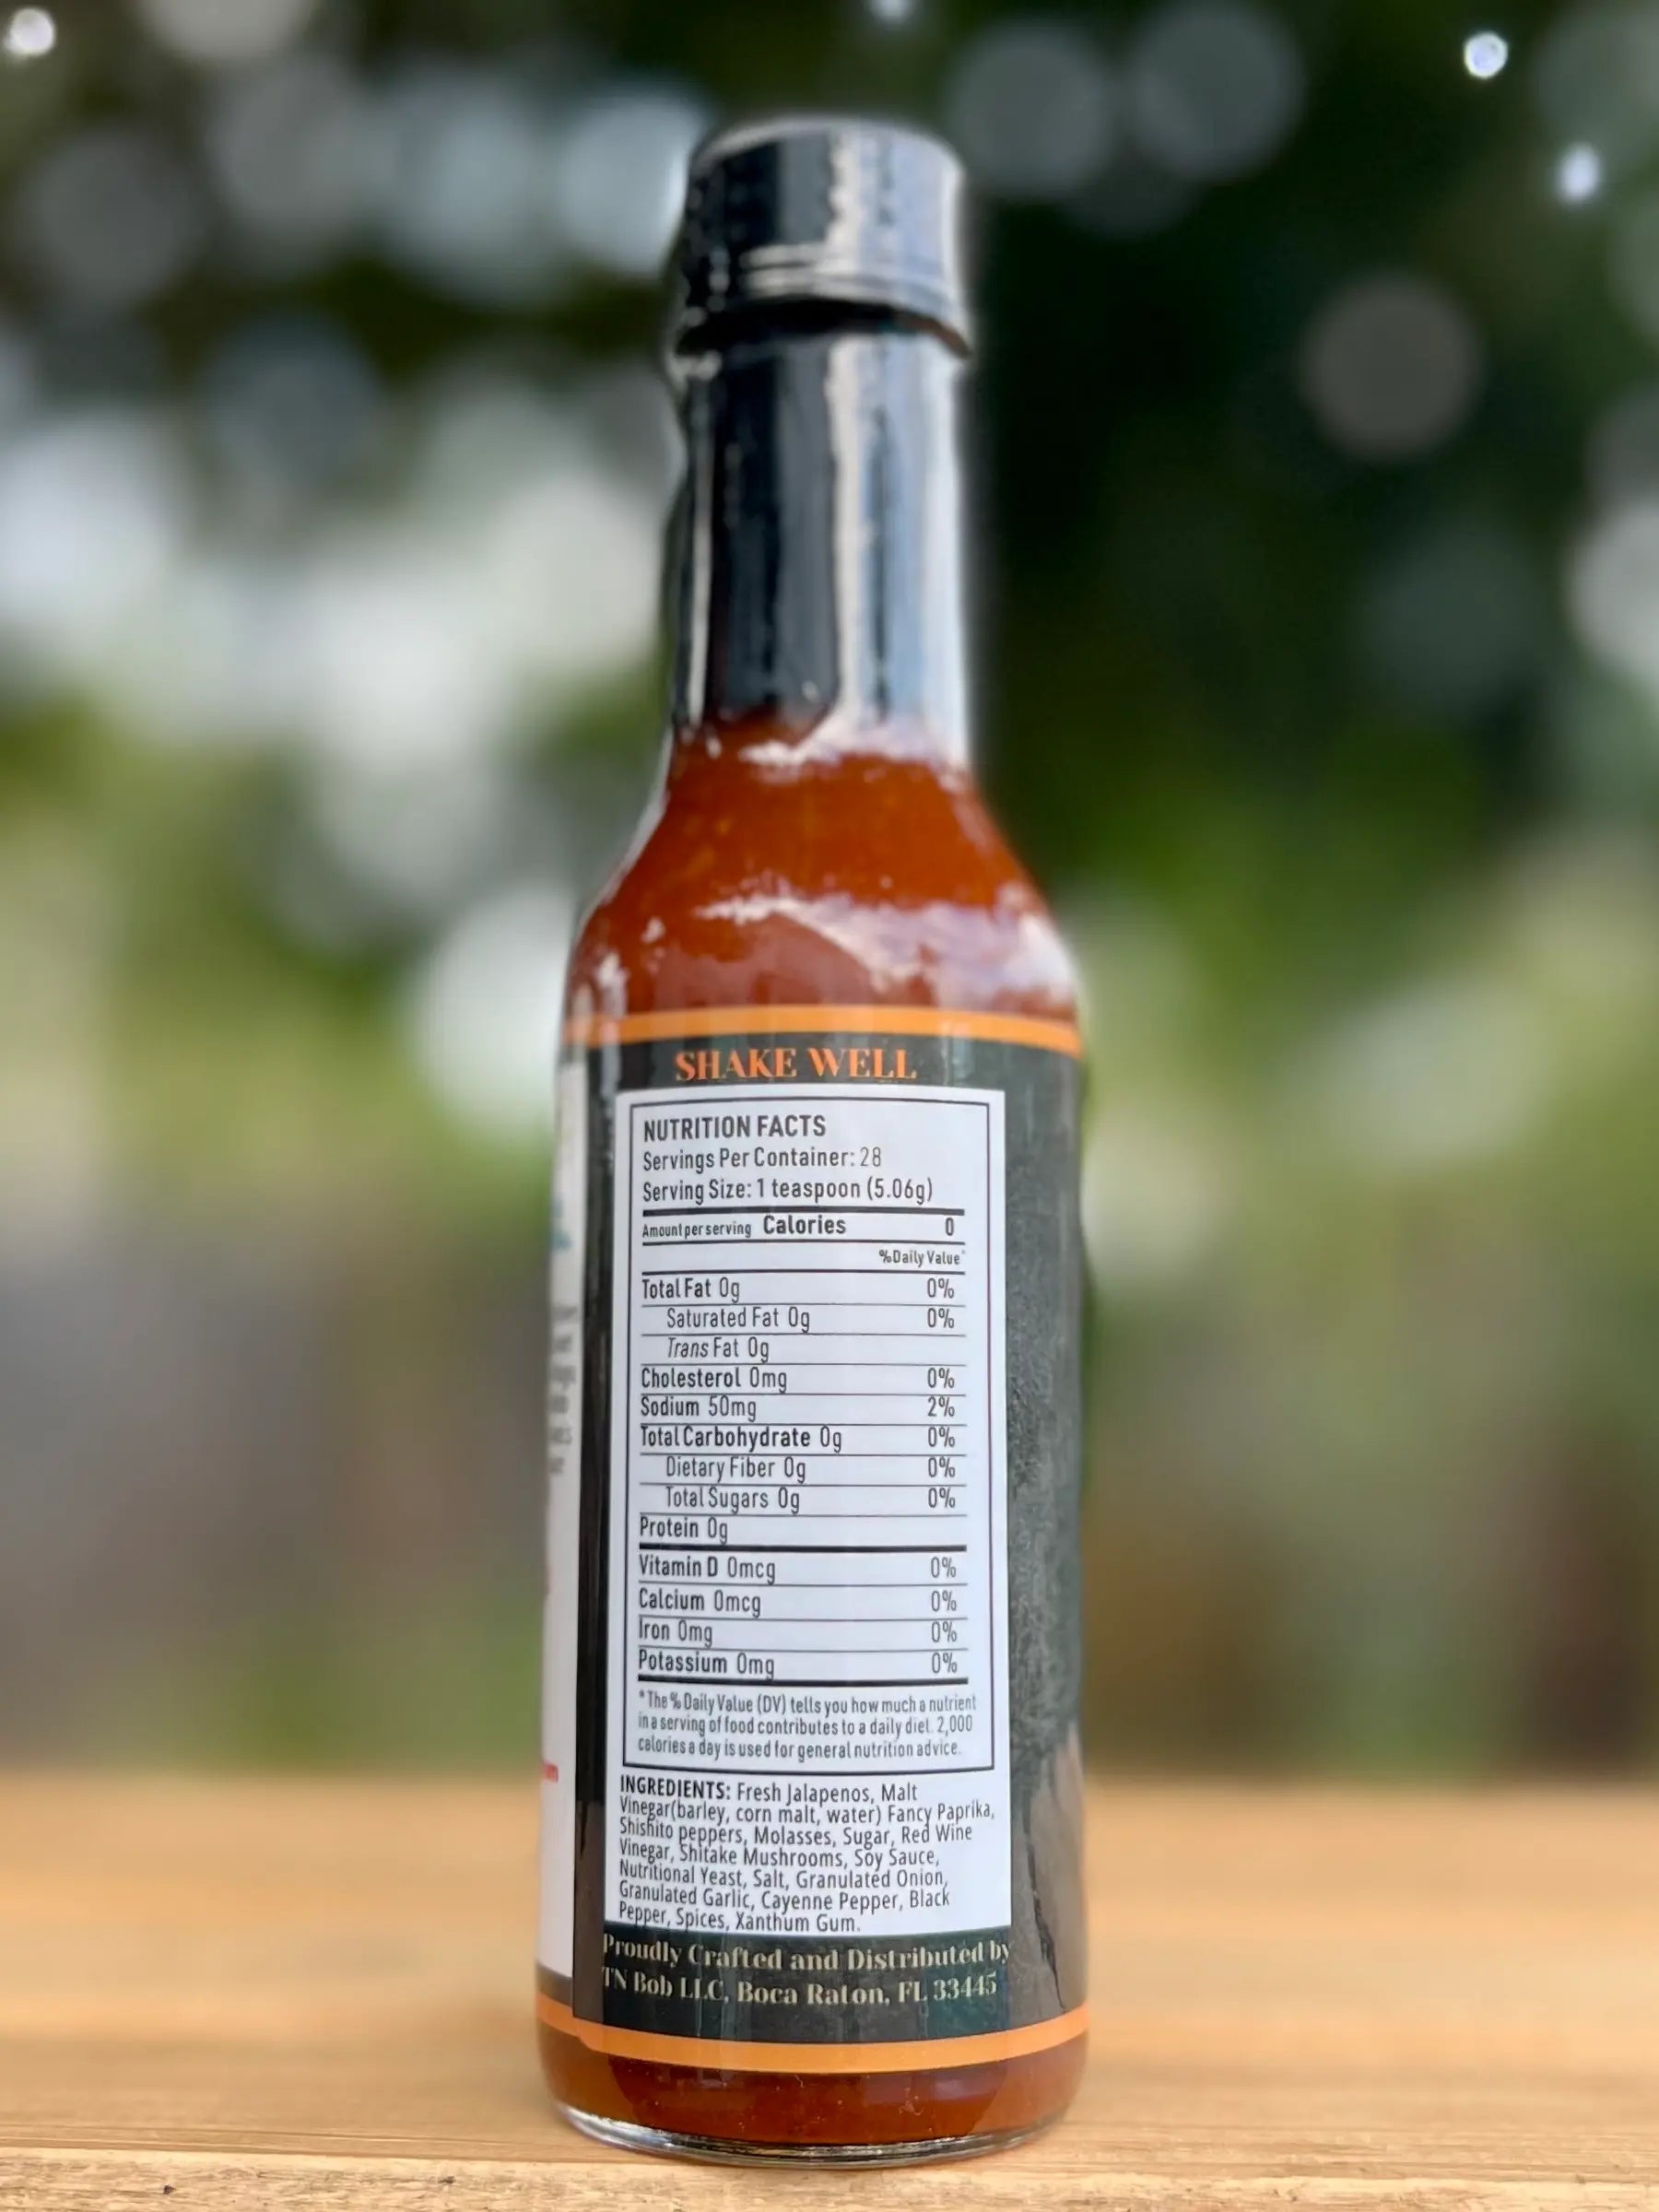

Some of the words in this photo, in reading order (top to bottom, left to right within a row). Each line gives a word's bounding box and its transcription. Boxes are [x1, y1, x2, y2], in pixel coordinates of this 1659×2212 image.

[676, 1047, 798, 1082] SHAKE
[807, 1047, 917, 1080] WELL
[644, 1115, 750, 1142] NUTRITION
[757, 1114, 826, 1137] FACTS
[643, 1149, 714, 1173] Servings
[720, 1147, 747, 1168] Per
[754, 1147, 854, 1167] Container:
[860, 1147, 882, 1167] 28
[643, 1181, 703, 1205] Serving
[709, 1179, 751, 1198] Size:
[757, 1179, 765, 1198] 1
[771, 1178, 860, 1203] teaspoon
[866, 1176, 933, 1205] (5.06g)
[642, 1223, 681, 1238] Amount
[705, 1222, 752, 1238] serving
[763, 1215, 846, 1235] Calories
[945, 1217, 955, 1236] 0
[642, 1278, 680, 1300] Total
[685, 1277, 711, 1298] Fat
[719, 1277, 740, 1302] 0g
[927, 1277, 955, 1299] 0%
[667, 1307, 747, 1328] Saturated
[752, 1307, 779, 1327] Fat
[788, 1307, 810, 1333] 0g
[927, 1307, 955, 1329] 0%
[667, 1337, 709, 1358] Trans
[713, 1337, 739, 1357] Fat
[748, 1337, 770, 1363] 0g
[641, 1367, 741, 1388] Cholesterol
[749, 1368, 787, 1394] 0mg
[927, 1368, 955, 1388] 0%
[641, 1396, 700, 1417] Sodium
[709, 1396, 757, 1421] 50mg
[927, 1396, 955, 1418] 2%
[641, 1426, 680, 1447] Total
[683, 1426, 810, 1450] Carbohydrate
[819, 1427, 842, 1453] 0g
[927, 1427, 955, 1448] 0%
[666, 1456, 724, 1479] Dietary
[731, 1456, 774, 1477] Fiber
[784, 1456, 806, 1482] 0g
[927, 1457, 955, 1477] 0%
[665, 1486, 704, 1507] Total
[708, 1486, 769, 1513] Sugars
[778, 1487, 800, 1514] 0g
[928, 1487, 956, 1508] 0%
[640, 1516, 699, 1538] Protein
[707, 1517, 728, 1544] 0g
[640, 1555, 703, 1577] Vitamin
[707, 1556, 719, 1577] D
[727, 1557, 776, 1584] 0mcg
[930, 1557, 957, 1578] 0%
[639, 1588, 705, 1611] Calcium
[713, 1590, 761, 1617] 0mcg
[931, 1590, 957, 1611] 0%
[639, 1619, 670, 1641] Iron
[677, 1620, 713, 1647] 0mg
[931, 1620, 958, 1641] 0%
[639, 1650, 728, 1673] Potassium
[736, 1653, 774, 1678] 0mg
[931, 1653, 958, 1674] 0%
[684, 1692, 715, 1715] Daily
[717, 1693, 753, 1712] Value
[758, 1693, 786, 1714] (DV)
[791, 1695, 821, 1713] tells
[824, 1700, 848, 1718] you
[851, 1696, 878, 1713] how
[881, 1696, 916, 1712] much
[919, 1700, 926, 1712] a
[929, 1693, 976, 1712] nutrient
[638, 1712, 649, 1729] in
[651, 1715, 658, 1729] a
[660, 1715, 705, 1736] serving
[709, 1715, 722, 1733] of
[724, 1715, 754, 1734] food
[758, 1716, 839, 1735] contributes
[841, 1719, 854, 1735] to
[858, 1722, 866, 1735] a
[870, 1716, 901, 1739] daily
[936, 1714, 972, 1736] 2,000
[638, 1735, 686, 1754] calories
[688, 1741, 695, 1755] a
[699, 1738, 721, 1761] day
[724, 1738, 735, 1756] is
[738, 1740, 771, 1758] used
[774, 1740, 794, 1759] for
[798, 1741, 852, 1763] general
[854, 1740, 913, 1759] nutrition
[620, 1775, 731, 1800] INGREDIENTS:
[737, 1783, 781, 1803] Fresh
[785, 1783, 875, 1807] Jalapenos,
[881, 1783, 917, 1802] Malt
[736, 1807, 771, 1822] corn
[779, 1805, 820, 1826] malt,
[828, 1805, 881, 1826] water)
[888, 1805, 932, 1826] Fancy
[937, 1799, 994, 1825] Paprika,
[620, 1817, 674, 1840] Shishito
[679, 1825, 747, 1847] peppers,
[755, 1826, 836, 1847] Molasses,
[842, 1827, 895, 1851] Sugar,
[901, 1824, 930, 1843] Red
[935, 1823, 972, 1841] Wine
[619, 1838, 675, 1865] Vinegar,
[680, 1843, 737, 1865] Shitake
[744, 1847, 848, 1869] Mushrooms,
[854, 1848, 883, 1871] Soy
[888, 1847, 939, 1866] Sauce,
[619, 1859, 695, 1884] Nutritional
[700, 1866, 747, 1888] Yeast,
[753, 1868, 789, 1889] Salt,
[796, 1869, 890, 1888] Granulated
[897, 1868, 948, 1890] Onion,
[619, 1880, 697, 1905] Granulated
[703, 1888, 755, 1912] Garlic,
[761, 1890, 833, 1914] Cayenne
[840, 1891, 903, 1915] Pepper,
[910, 1888, 950, 1909] Black
[619, 1900, 671, 1926] Pepper,
[676, 1907, 731, 1932] Spices,
[735, 1911, 809, 1932] Xanthum
[817, 1913, 861, 1933] Gum.
[603, 1933, 682, 1968] Proudly
[688, 1944, 782, 1970] Crafted
[790, 1948, 839, 1971] and
[847, 1941, 983, 1971] Distributed
[989, 1939, 1009, 1965] by
[633, 1971, 673, 1997] Bob
[737, 1980, 798, 2005] Boca
[807, 1983, 891, 2006] Raton,
[898, 1981, 928, 2004] FL
[934, 1971, 997, 2001] 33445
